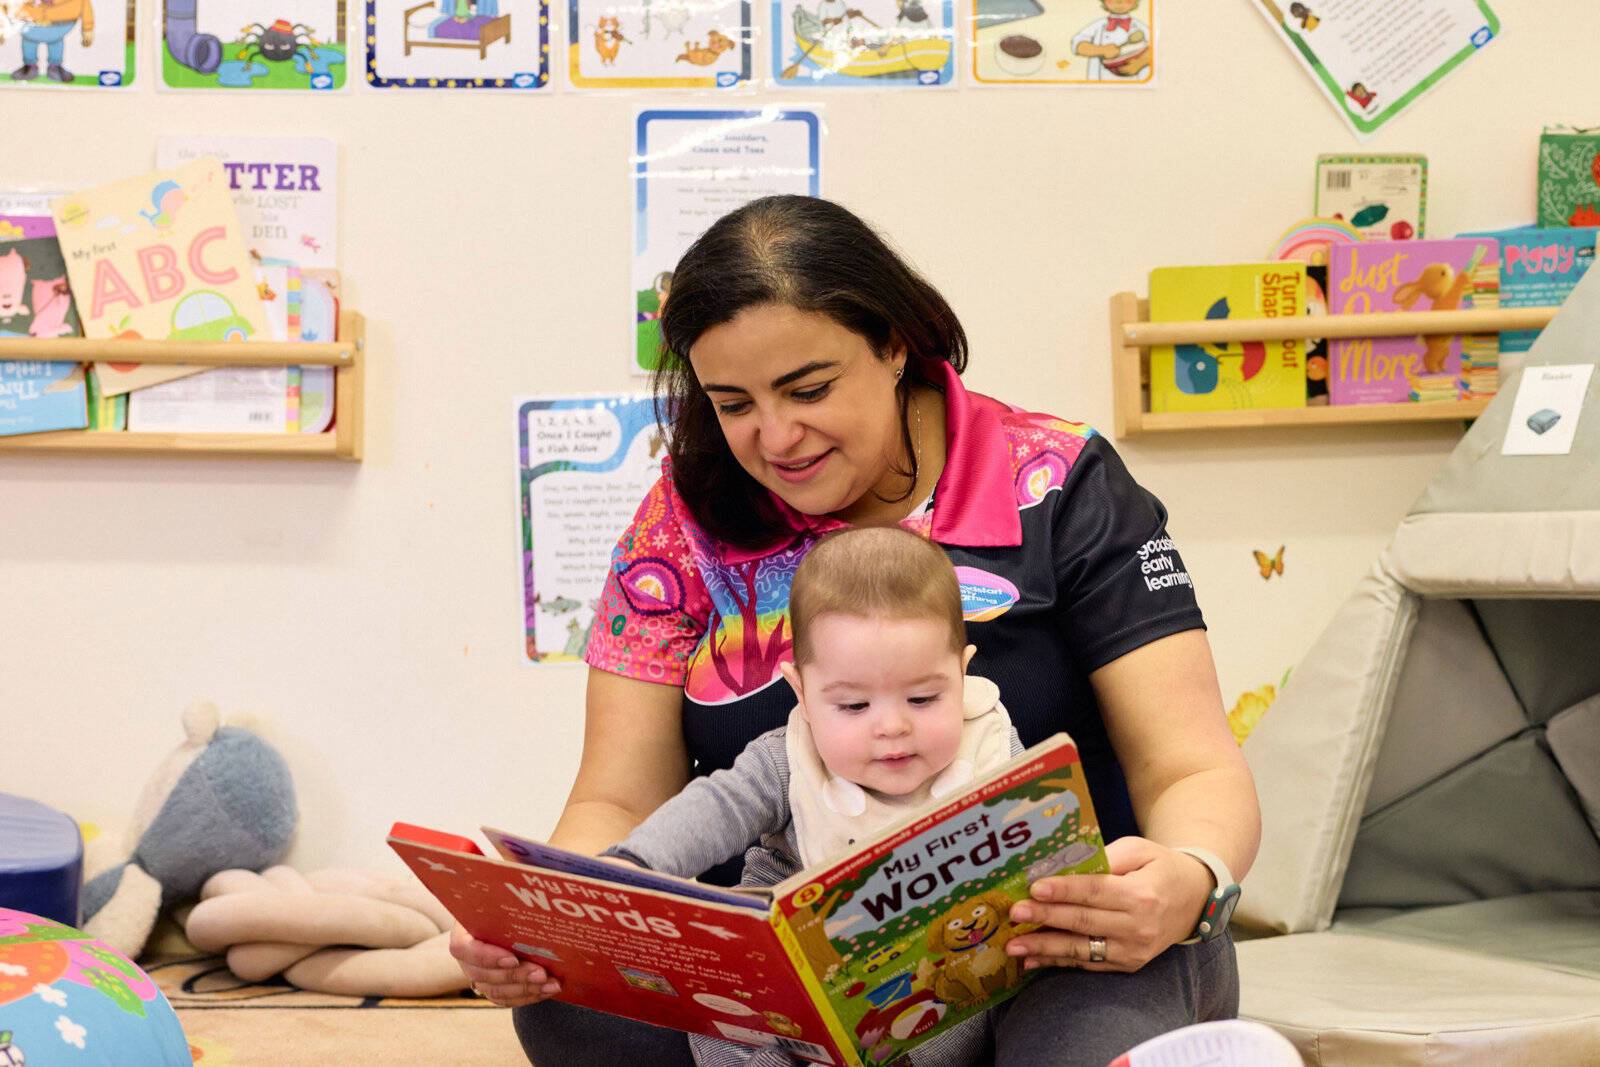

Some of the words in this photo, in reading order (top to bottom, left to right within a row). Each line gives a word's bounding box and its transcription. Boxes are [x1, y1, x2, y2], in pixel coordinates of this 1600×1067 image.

[223, 162, 321, 191] TTER
[72, 249, 91, 261] My
[92, 241, 117, 255] first
[1340, 247, 1409, 293] Just
[89, 225, 241, 320] ABC
[1263, 272, 1281, 318] Shap
[1339, 338, 1422, 385] More
[537, 430, 563, 440] Once
[574, 429, 612, 442] Caught
[547, 444, 570, 454] Fish
[574, 443, 598, 453] Alive
[1141, 554, 1174, 574] early
[883, 852, 922, 882] My
[924, 812, 992, 858] First
[521, 872, 562, 895] My
[566, 881, 633, 907] First
[860, 818, 1034, 923] Words
[504, 882, 683, 939] Words
[914, 1019, 935, 1035] ball
